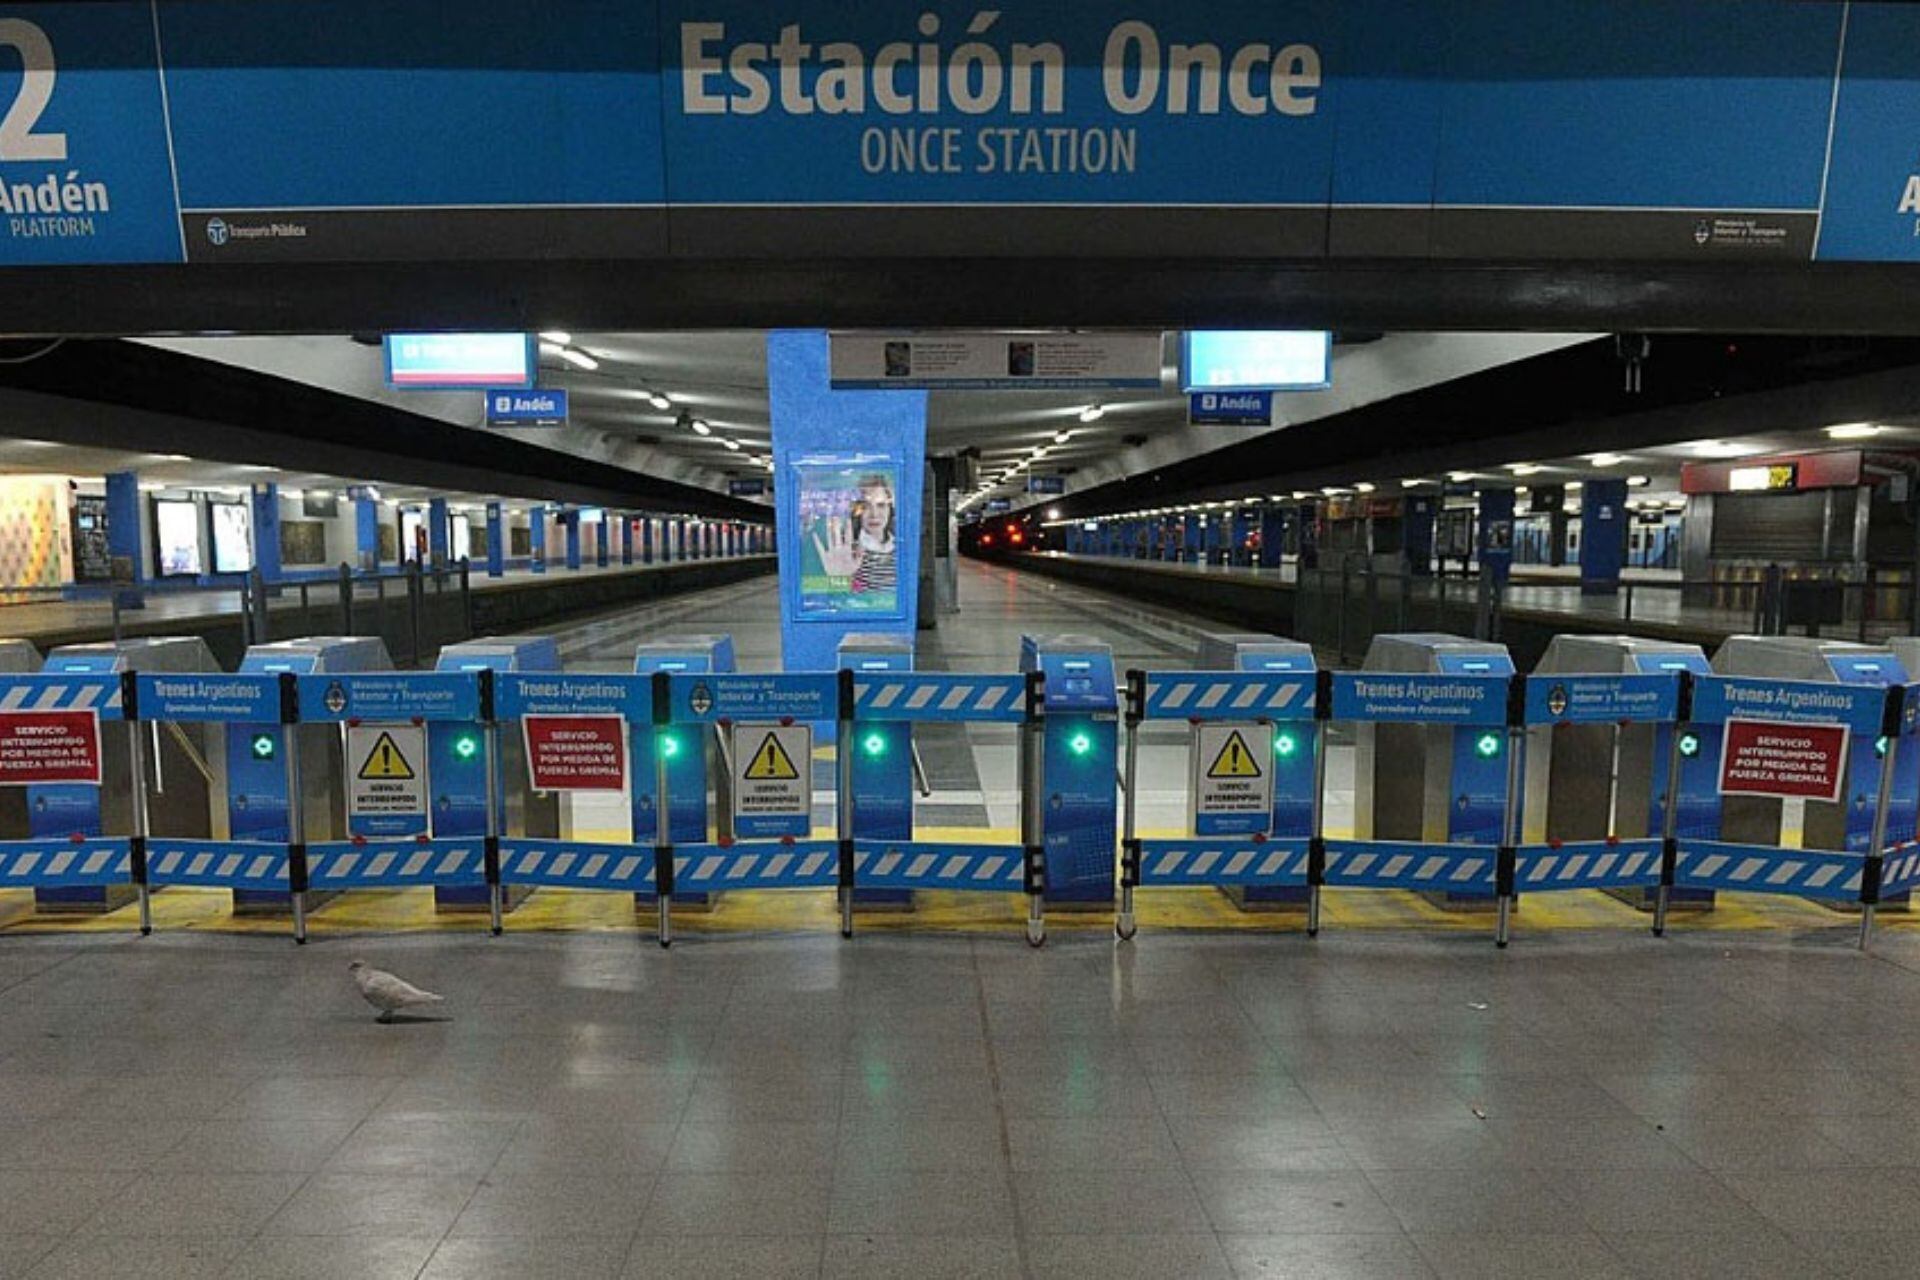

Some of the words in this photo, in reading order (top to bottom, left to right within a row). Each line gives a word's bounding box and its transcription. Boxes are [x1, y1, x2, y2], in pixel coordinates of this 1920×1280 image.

[681, 11, 1064, 115] Estación
[1102, 19, 1322, 116] Once
[0, 17, 68, 162] 2
[860, 126, 963, 174] ONCE
[975, 126, 1137, 174] STATION
[9, 216, 96, 238] PLATFORM
[513, 396, 556, 412] Andén
[1219, 393, 1263, 411] Andén
[153, 681, 196, 698] Trenes
[198, 681, 262, 701] Argentinos
[518, 680, 560, 698] Trenes
[561, 680, 627, 701] Argentinos
[1354, 680, 1405, 698] Trenes
[1406, 680, 1486, 702] Argentinos
[1723, 683, 1775, 704] Trenes
[1775, 688, 1854, 710] Argentinos
[14, 726, 69, 735] SERVICIO
[551, 730, 599, 741] SERVICIO
[1, 736, 86, 746] INTERRUMPIDO
[538, 742, 615, 753] INTERRUMPIDO
[1757, 735, 1812, 748] SERVICIO
[1, 749, 25, 758] POR
[26, 748, 71, 757] MEDIDA
[71, 747, 88, 757] DE
[540, 753, 560, 764] POR
[561, 753, 601, 764] MEDIDA
[602, 753, 617, 764] DE
[1739, 746, 1827, 761] INTERRUMPIDO
[44, 758, 93, 769] GREMIAL
[538, 764, 577, 776] FUERZA
[579, 764, 621, 776] GREMIAL
[1735, 758, 1761, 767] POR
[1762, 759, 1807, 772] MEDIDA
[1808, 763, 1827, 773] DE
[1728, 769, 1775, 780] FUERZA
[1777, 772, 1831, 785] GREMIAL
